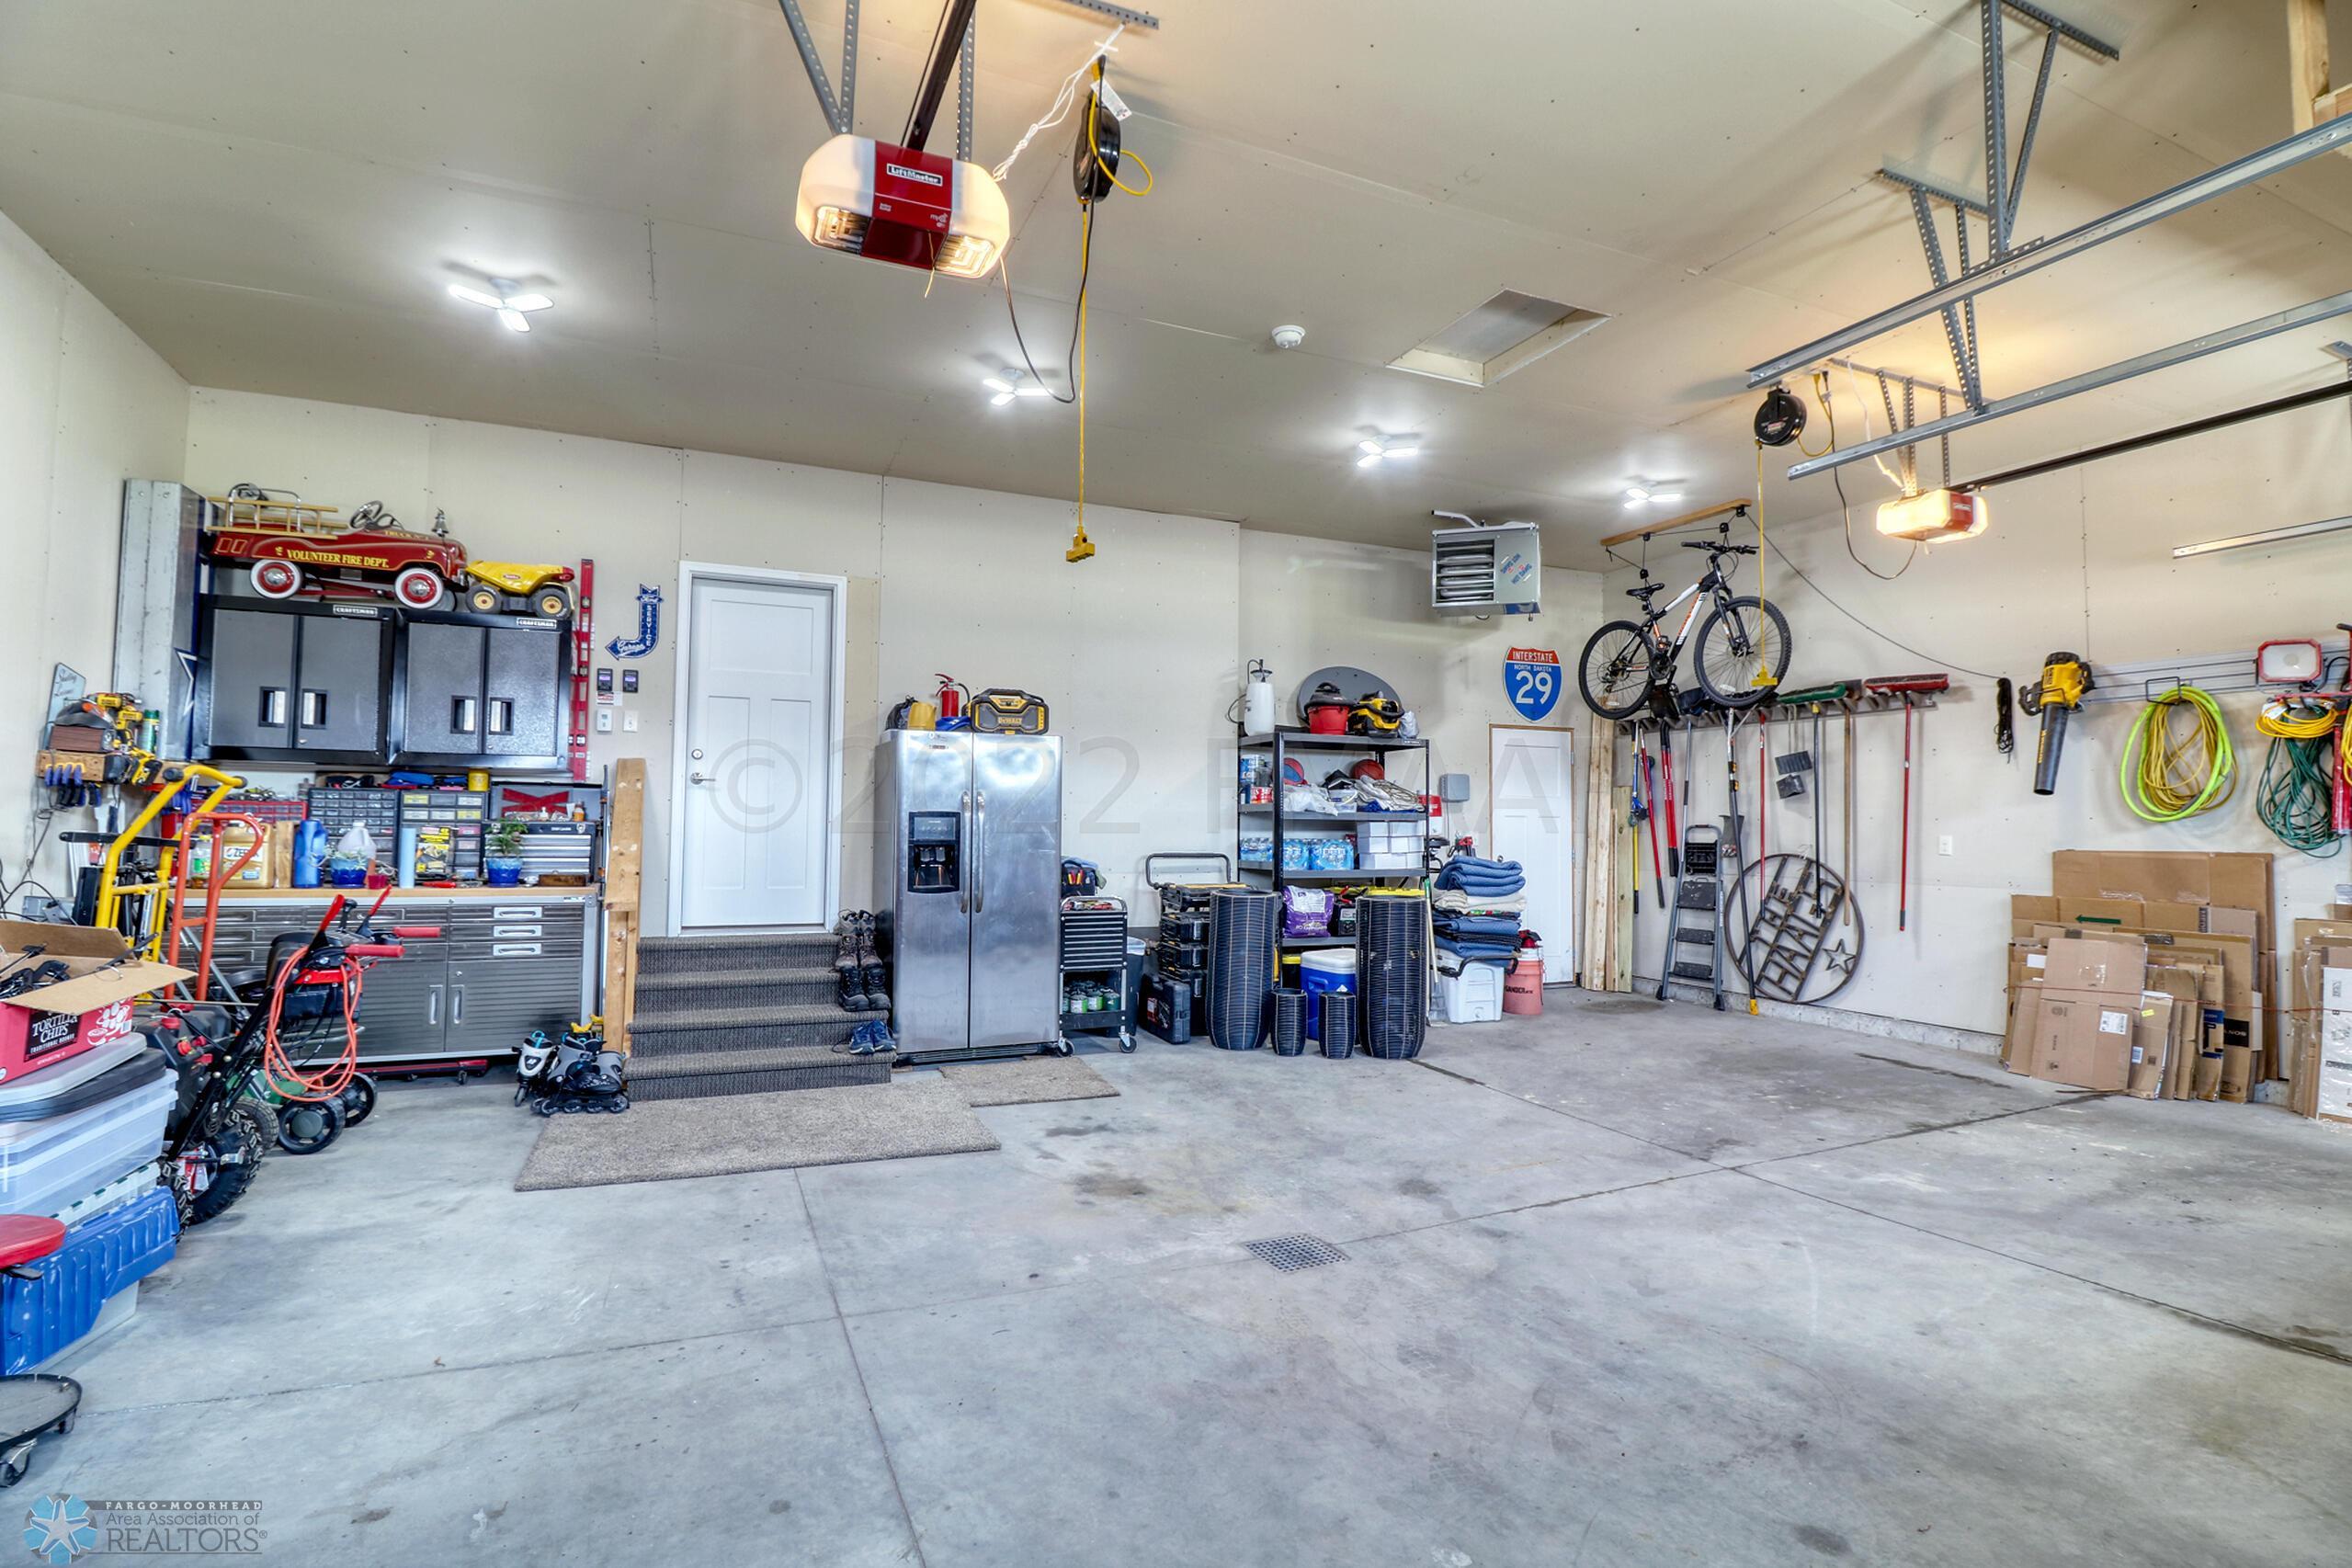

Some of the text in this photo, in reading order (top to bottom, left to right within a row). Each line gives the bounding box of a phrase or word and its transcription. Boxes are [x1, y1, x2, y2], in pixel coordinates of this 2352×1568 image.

[891, 165, 938, 184] LiftMaster
[286, 549, 390, 569] VOLUNTEER FIRE DEPT.
[335, 606, 376, 616] CRAFTSMAN
[1512, 651, 1553, 664] INTERSTATE
[1516, 670, 1552, 705] 29
[32, 1014, 78, 1037] TORTILLA
[40, 1023, 70, 1043] CHIPS
